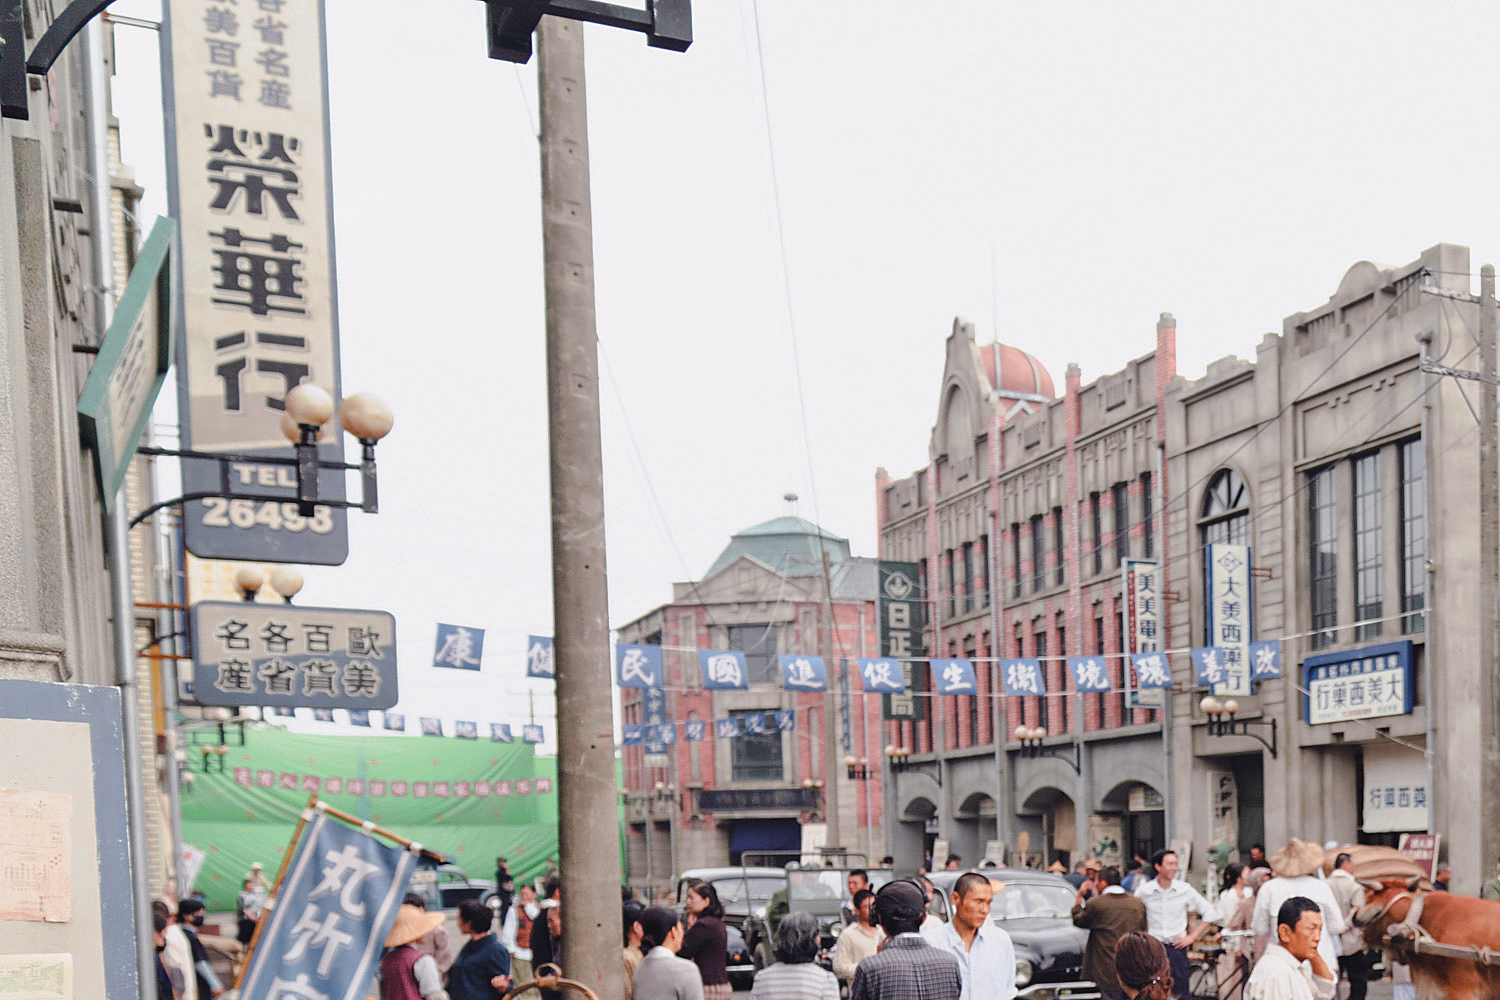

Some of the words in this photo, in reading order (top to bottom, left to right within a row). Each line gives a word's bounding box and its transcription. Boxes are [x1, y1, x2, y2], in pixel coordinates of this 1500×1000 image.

[203, 0, 244, 103] 美百貨
[203, 122, 311, 412] 榮華行
